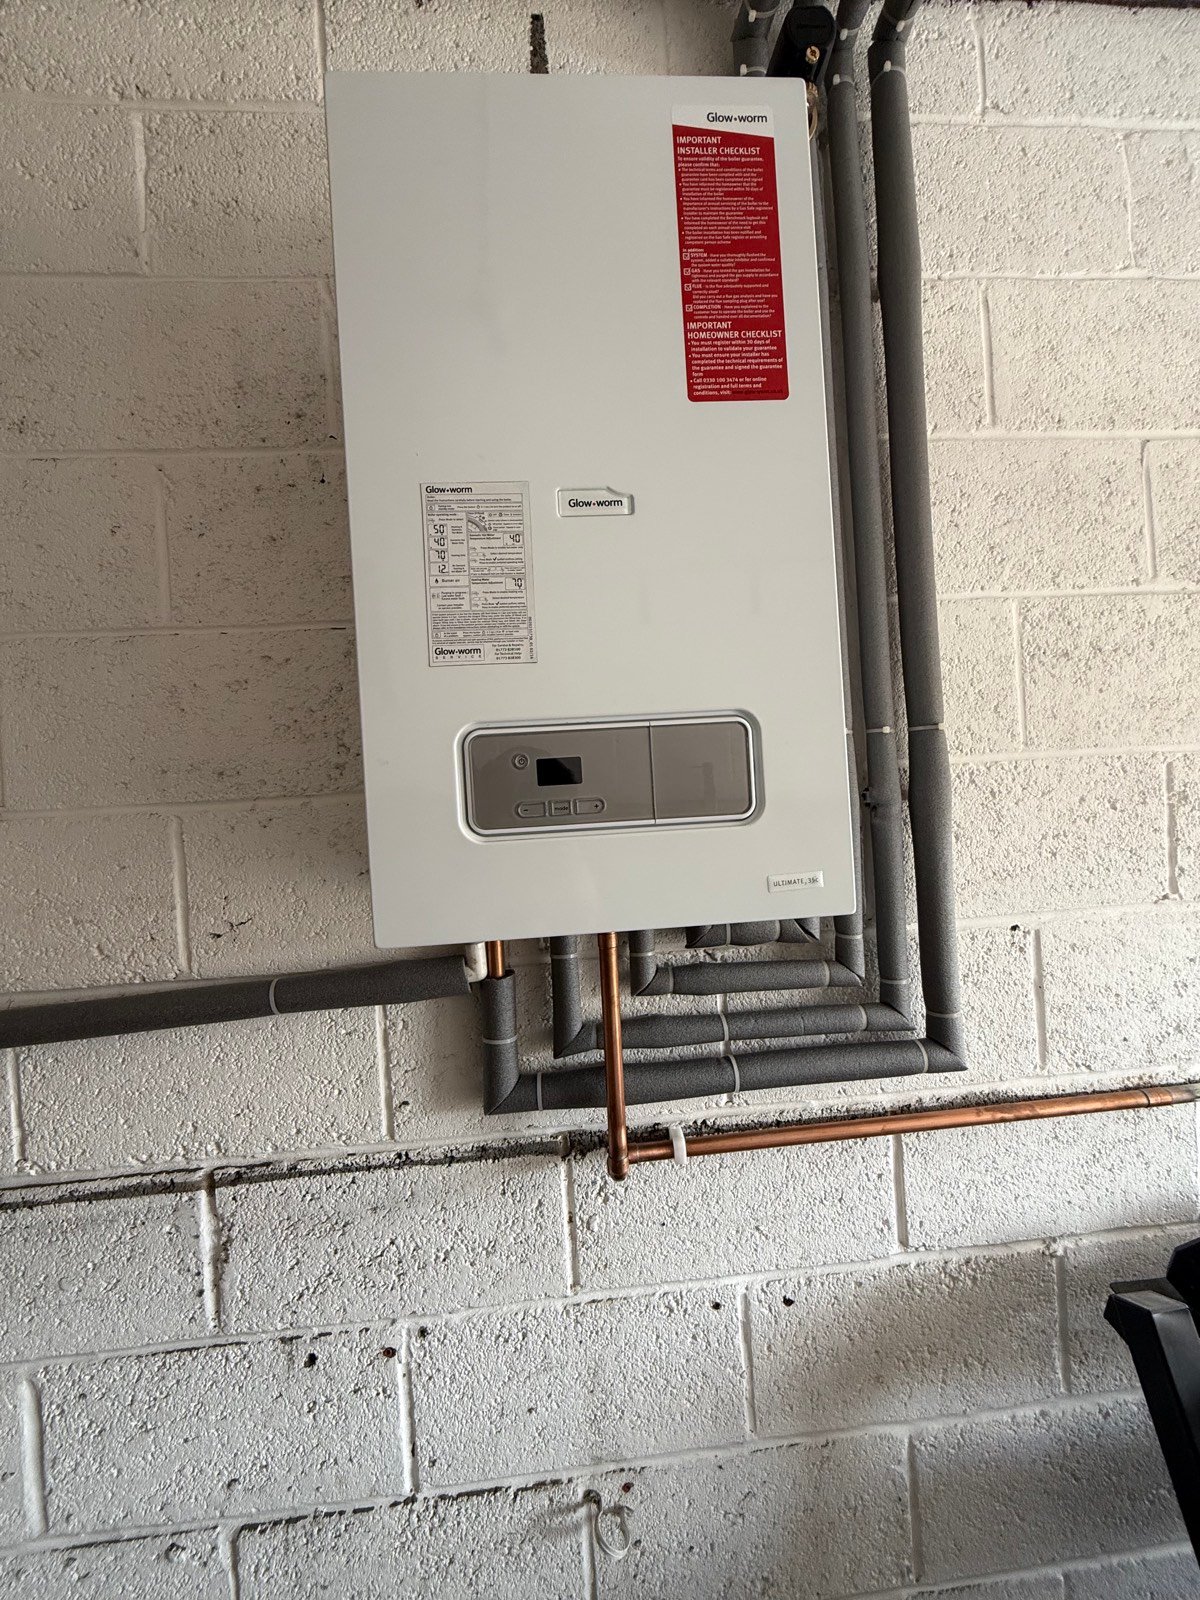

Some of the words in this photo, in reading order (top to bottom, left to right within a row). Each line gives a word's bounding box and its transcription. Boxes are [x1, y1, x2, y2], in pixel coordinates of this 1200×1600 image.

[676, 136, 721, 144] IMPORTANT
[677, 146, 718, 155] INSTALLER
[719, 147, 760, 155] CHECKLIST
[687, 321, 731, 330] IMPORTANT
[687, 331, 739, 339] HOMEOWNER
[740, 330, 782, 338] CHECKLIST
[434, 524, 445, 534] 50
[434, 538, 445, 546] 40
[509, 534, 520, 543] 40
[438, 565, 447, 573] 12
